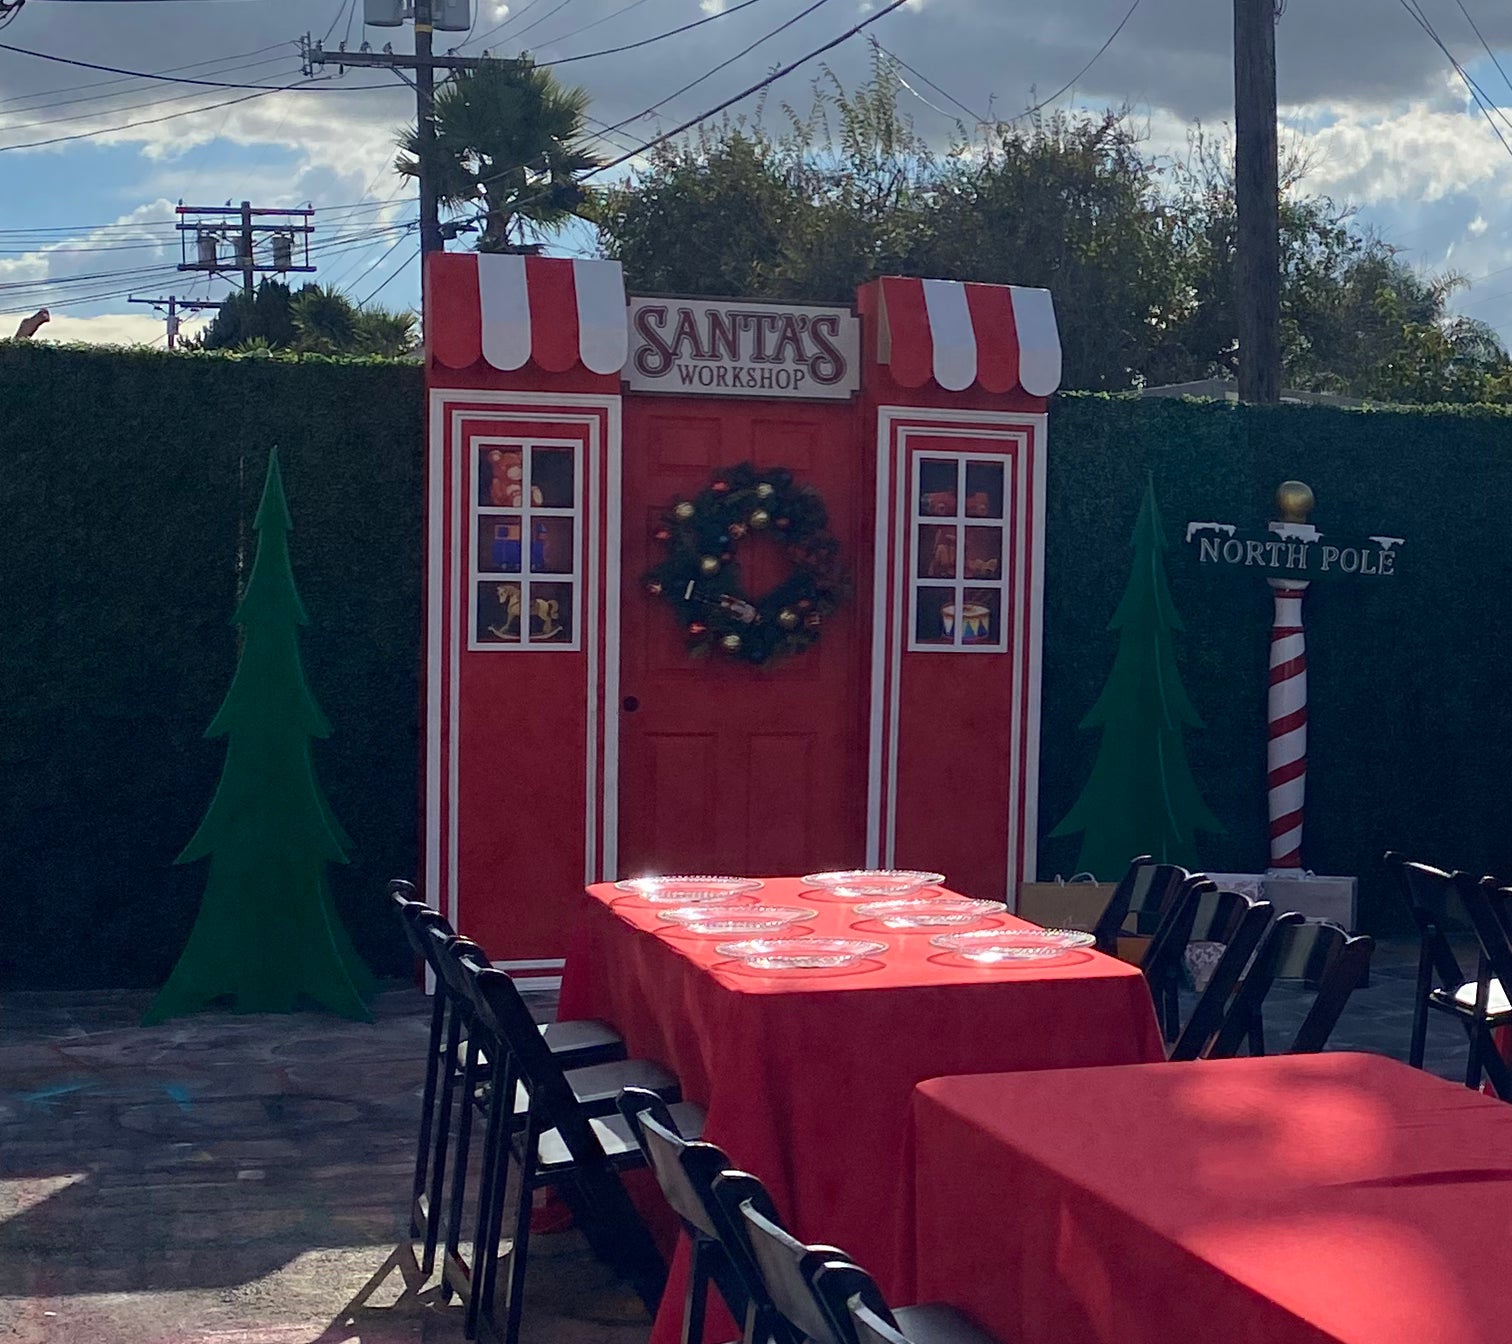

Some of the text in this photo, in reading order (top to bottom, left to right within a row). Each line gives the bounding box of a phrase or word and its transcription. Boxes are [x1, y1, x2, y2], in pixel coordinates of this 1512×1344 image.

[634, 305, 847, 385] SANTA'S
[677, 364, 805, 390] WORKSHOP
[1200, 537, 1396, 575] NORTH POLE
